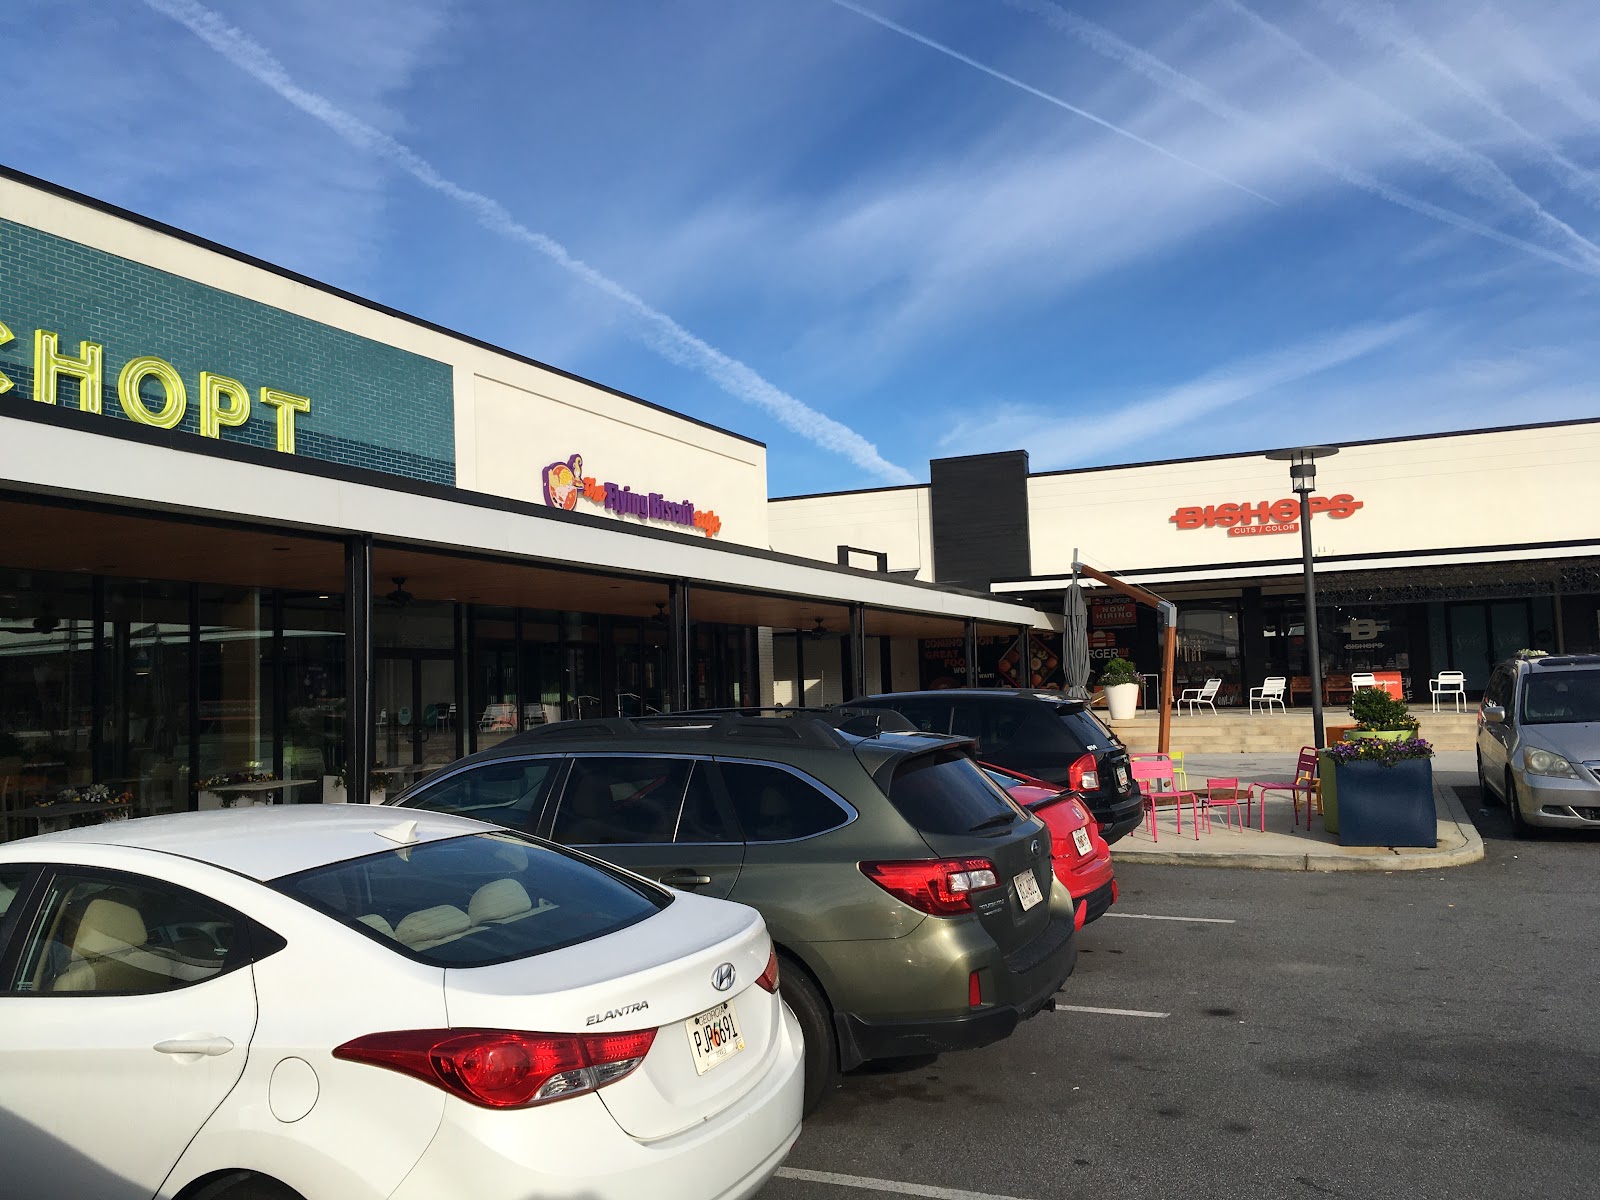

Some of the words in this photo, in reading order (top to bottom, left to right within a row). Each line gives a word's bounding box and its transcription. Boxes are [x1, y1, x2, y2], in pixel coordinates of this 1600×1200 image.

[0, 320, 311, 455] HOPT
[604, 481, 648, 519] Flying
[649, 492, 695, 526] Biscuit
[1169, 494, 1364, 530] BISHOPS
[1234, 526, 1256, 534] CUTS
[1265, 524, 1295, 532] COLOR
[1102, 605, 1125, 613] NOW
[924, 637, 963, 648] COMING
[1344, 642, 1385, 650] BISHOPS
[925, 650, 959, 659] GREAT
[943, 658, 966, 668] FOO
[585, 1000, 649, 1027] ELANTRA
[698, 1005, 727, 1026] GEORGIA
[693, 1012, 738, 1058] PJP6691
